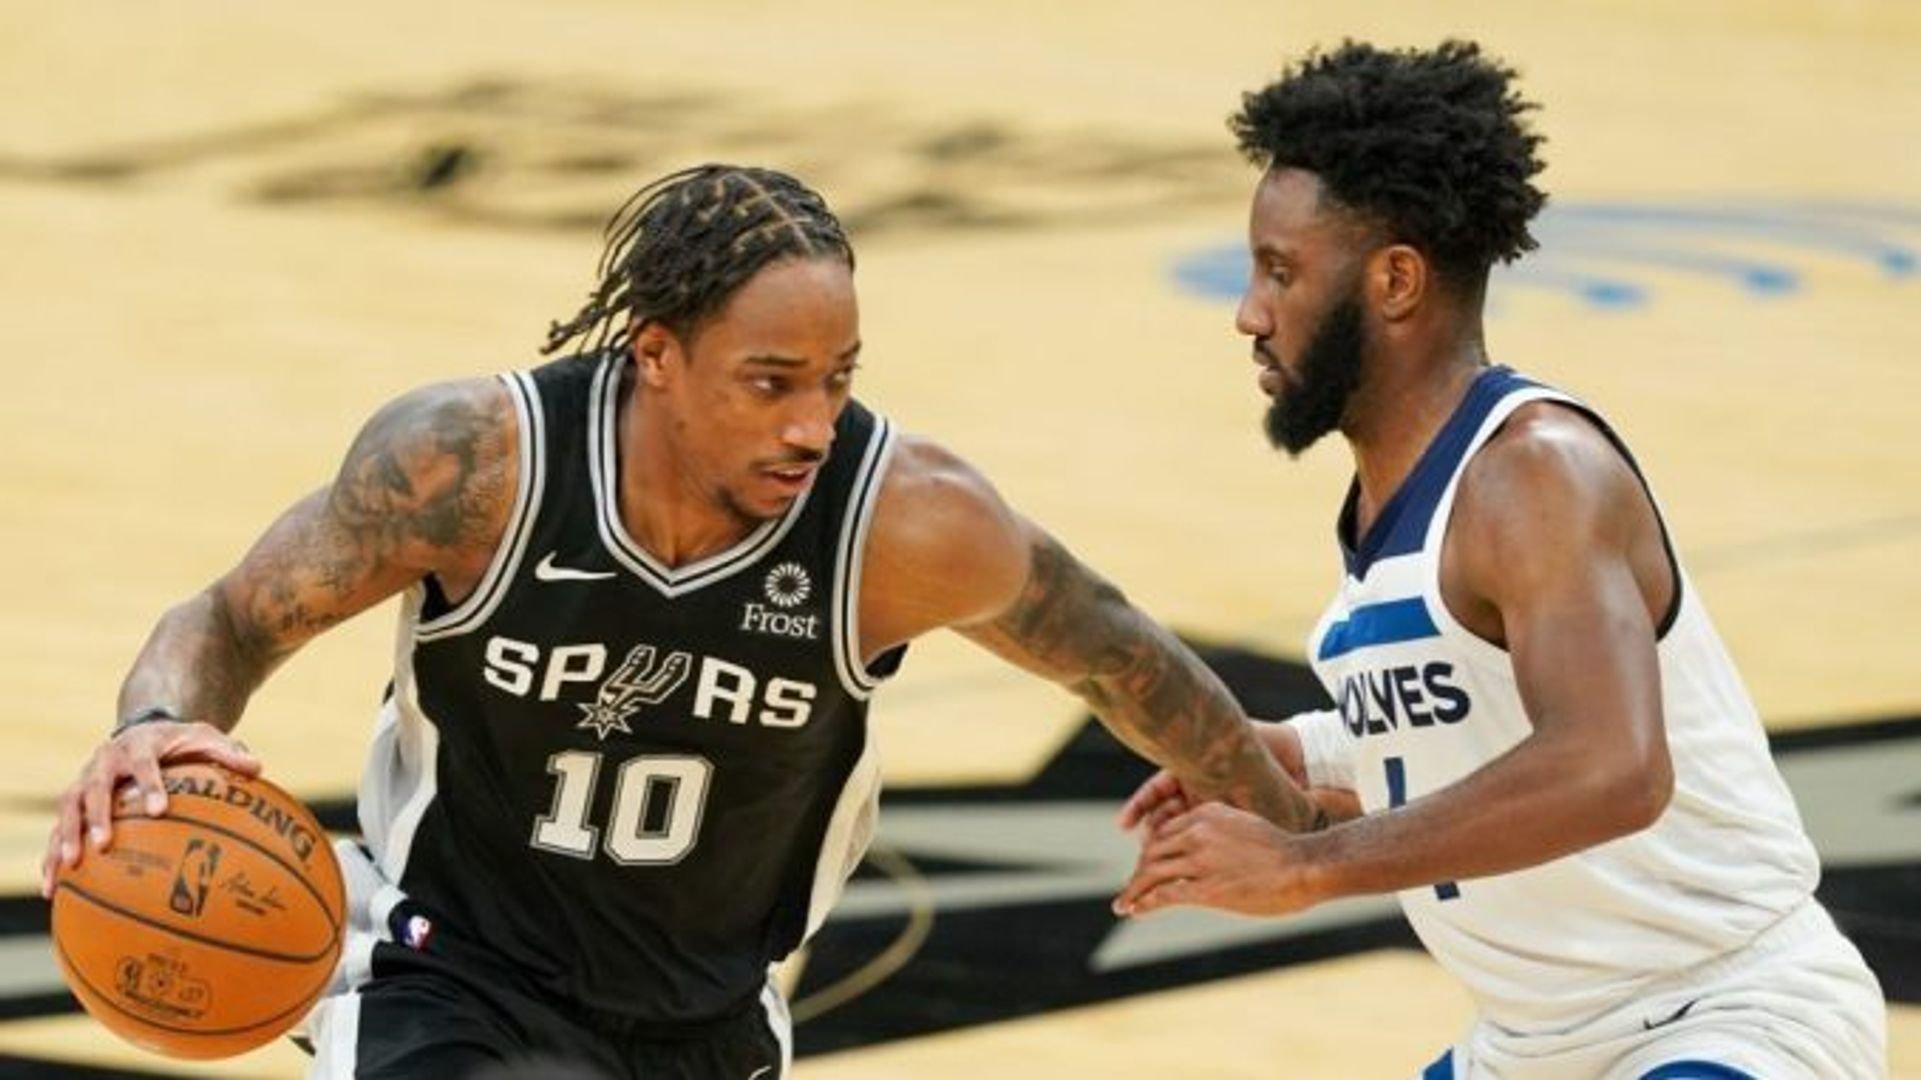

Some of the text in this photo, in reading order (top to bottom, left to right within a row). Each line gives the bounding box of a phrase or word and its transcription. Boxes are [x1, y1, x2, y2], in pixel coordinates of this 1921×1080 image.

[740, 602, 821, 640] Frost
[484, 635, 818, 740] SPURS
[1338, 661, 1471, 738] OLVES
[529, 749, 715, 866] 10
